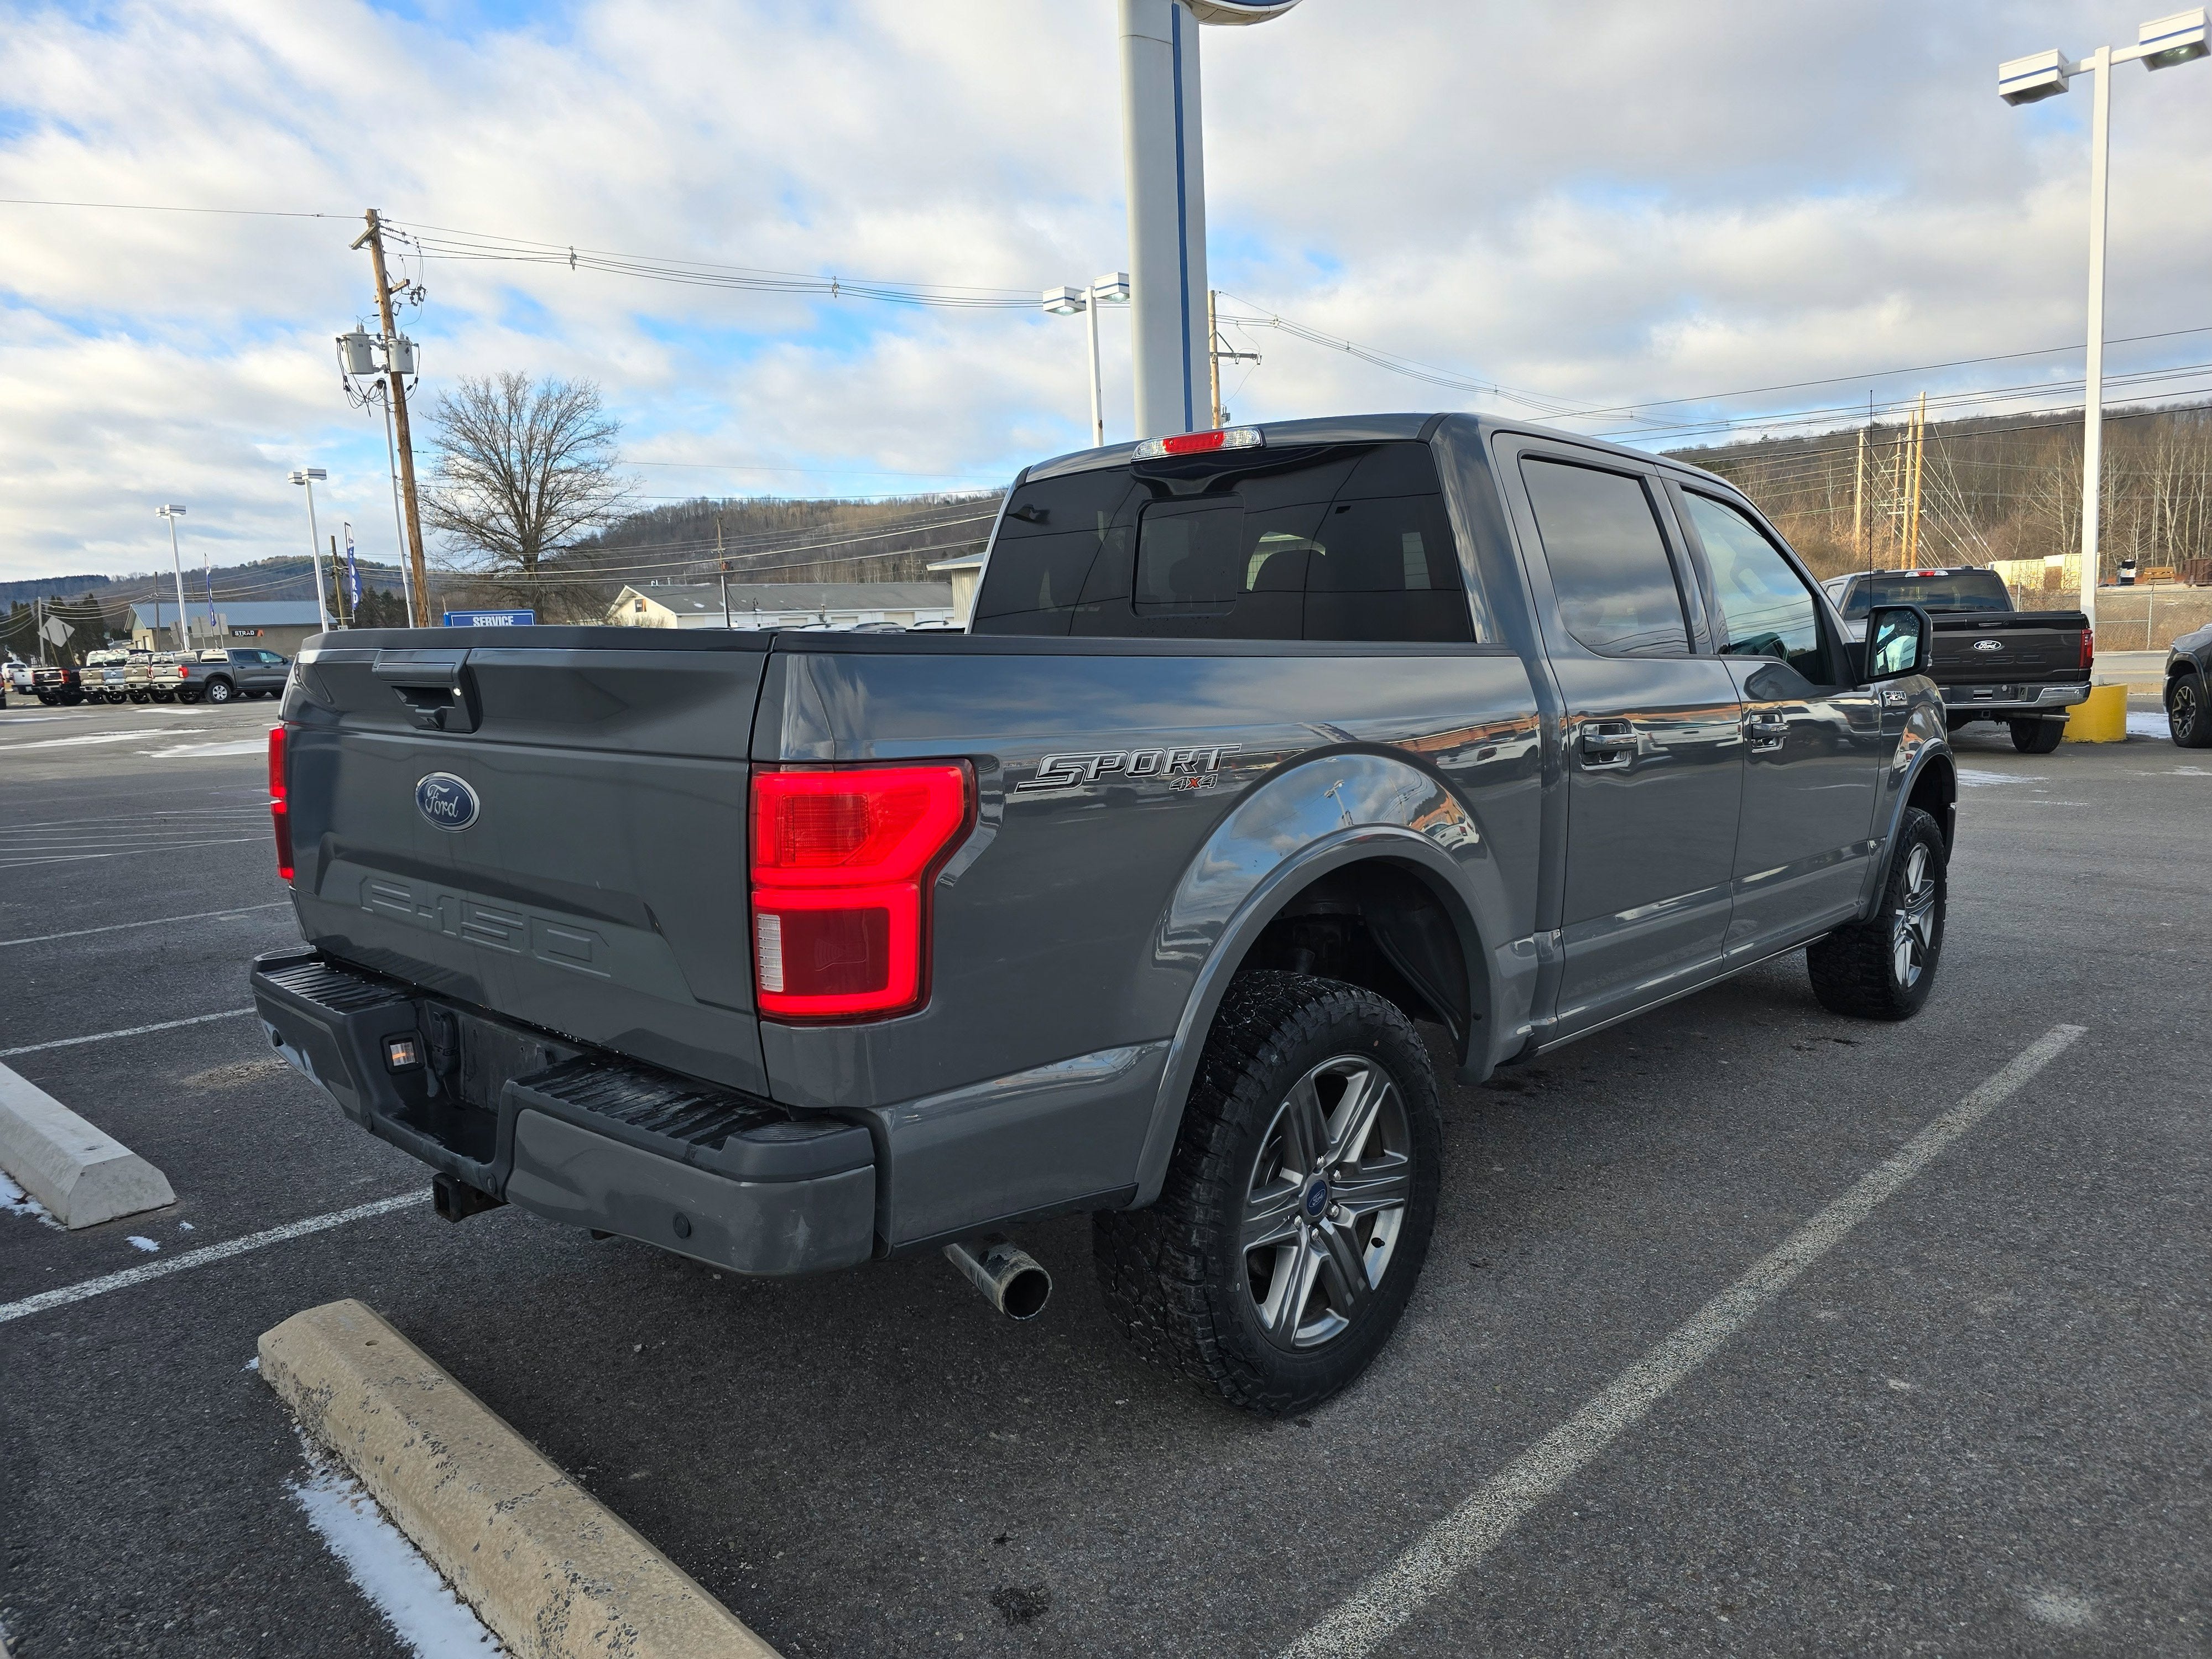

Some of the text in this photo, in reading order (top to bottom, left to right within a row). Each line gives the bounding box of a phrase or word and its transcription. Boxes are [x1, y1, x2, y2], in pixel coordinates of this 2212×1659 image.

[472, 615, 514, 627] SERVICE
[1978, 641, 1996, 650] Ford
[1014, 743, 1242, 794] SPORT
[425, 784, 459, 818] Ford
[359, 875, 611, 978] F-150
